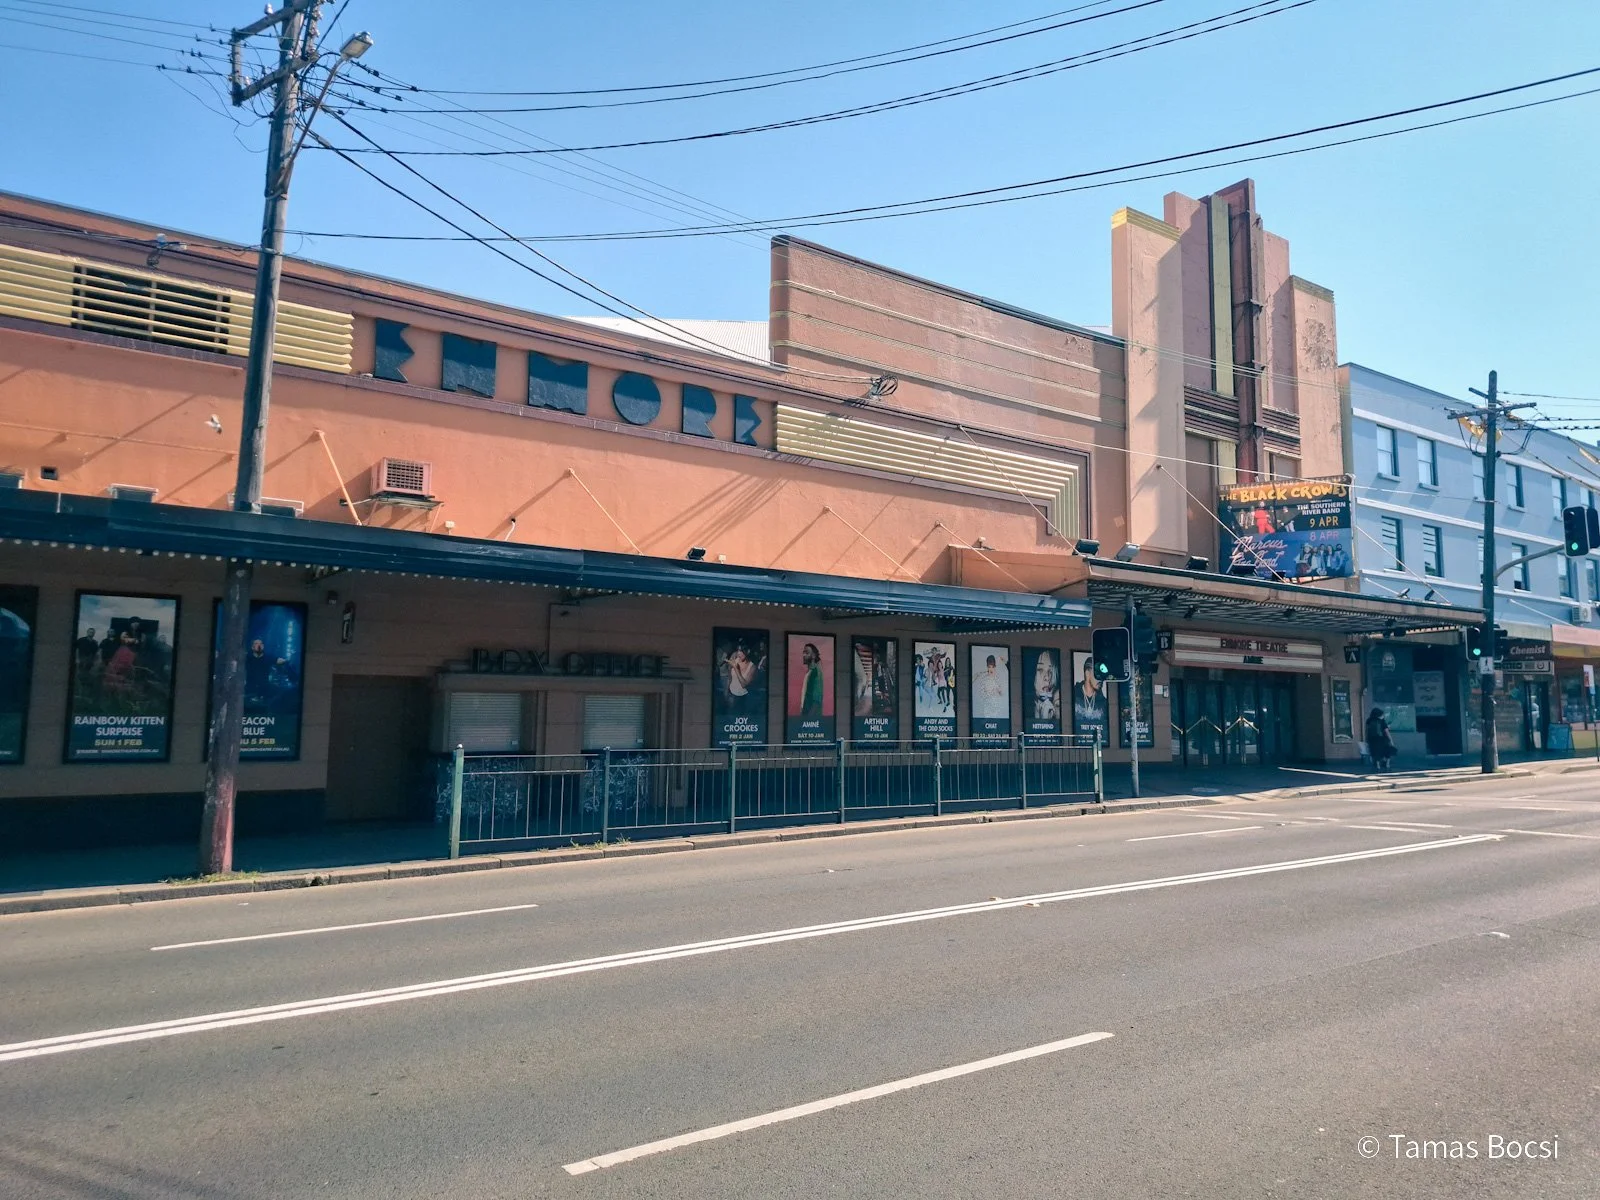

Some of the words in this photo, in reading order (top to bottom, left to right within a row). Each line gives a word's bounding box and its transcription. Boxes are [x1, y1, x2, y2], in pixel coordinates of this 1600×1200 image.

[374, 317, 762, 447] ENMORE
[1219, 493, 1238, 501] THE
[1239, 487, 1288, 503] BLACK
[1290, 482, 1347, 500] CROWES
[1310, 500, 1347, 510] SOUTHERN
[1301, 508, 1318, 516] RIVER
[1309, 518, 1315, 528] 9
[1318, 515, 1339, 527] APR
[1309, 532, 1316, 541] 8
[1320, 530, 1340, 540] APR
[1231, 535, 1288, 556] Marcus
[1256, 640, 1289, 654] THEATRE
[1509, 645, 1546, 656] Chemist
[74, 715, 128, 726] RAINBOW
[130, 715, 165, 726] KITTEN
[241, 716, 275, 726] EACON
[734, 717, 749, 725] JOY
[863, 717, 889, 725] ARTHUR
[95, 726, 144, 737] SURPRISE
[242, 726, 266, 736] BLUE
[723, 724, 759, 733] CROOKES
[870, 724, 883, 732] HILL
[94, 738, 115, 747] SUN
[123, 738, 143, 746] FEB
[258, 737, 276, 745] FEB
